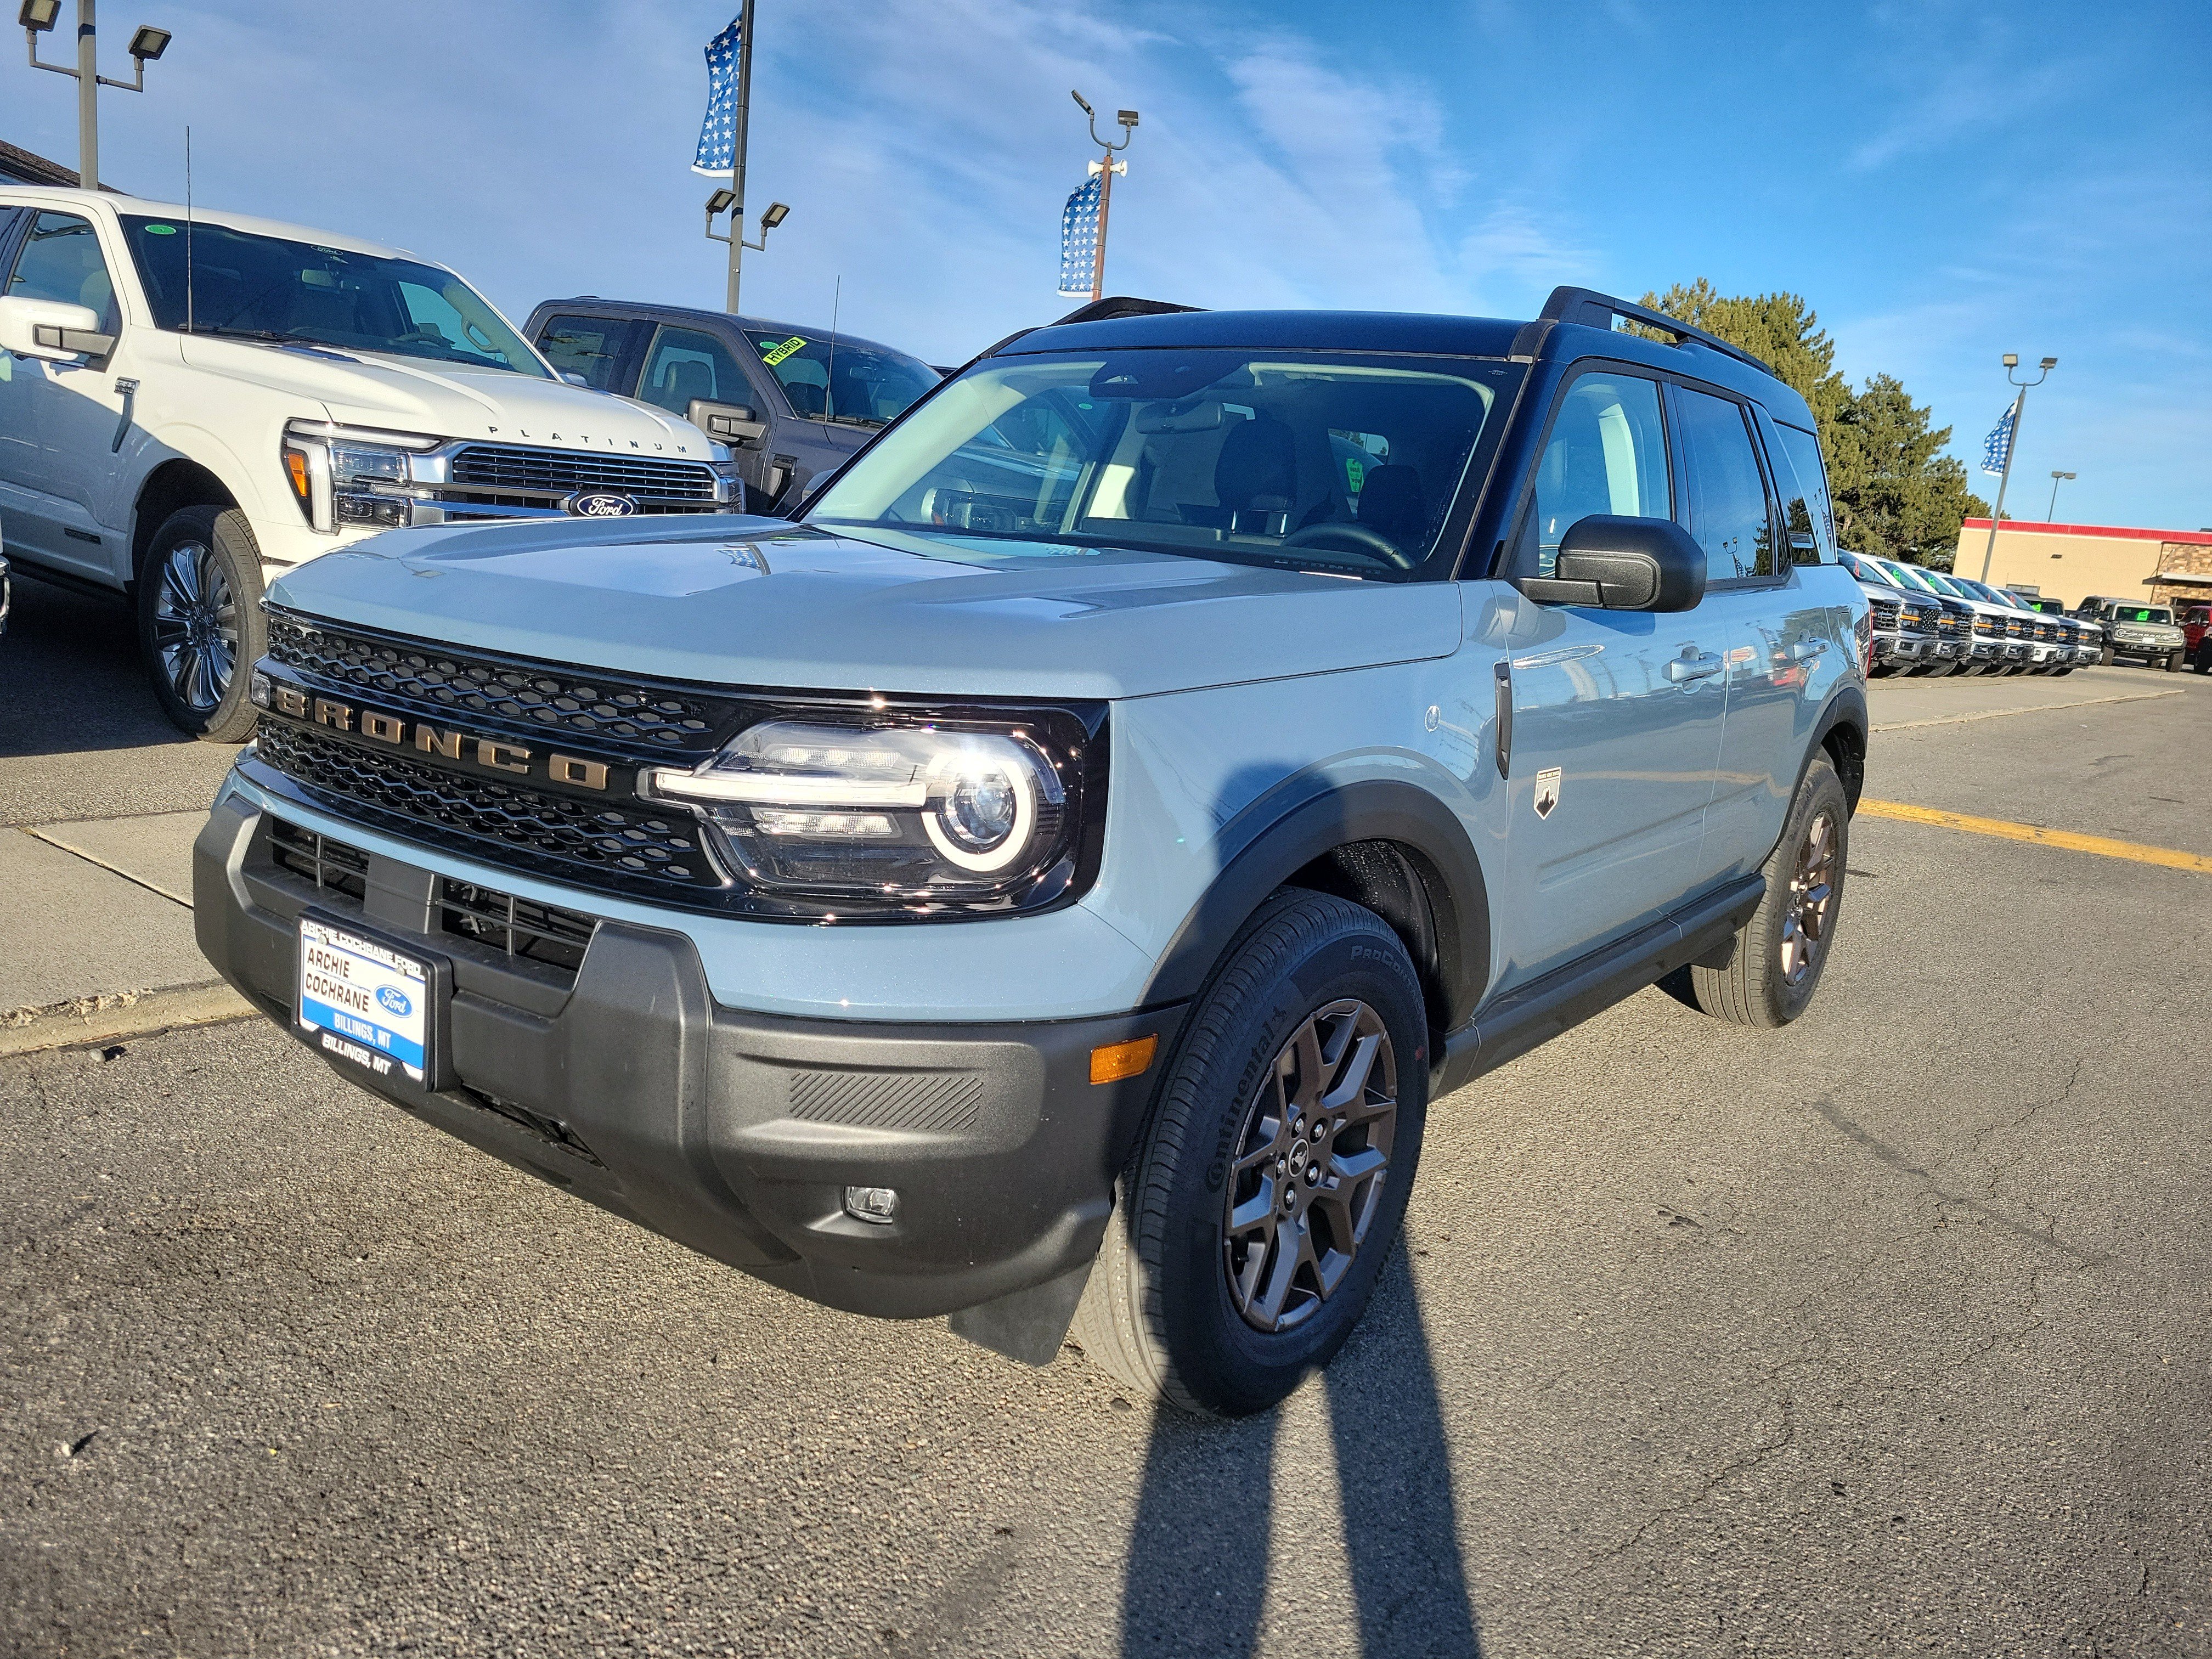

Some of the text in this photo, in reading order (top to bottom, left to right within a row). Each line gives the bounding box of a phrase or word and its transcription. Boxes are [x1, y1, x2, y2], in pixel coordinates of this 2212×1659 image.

[767, 339, 800, 363] HYBRID
[488, 426, 687, 453] PLATINUM
[588, 498, 623, 515] Ford
[276, 685, 608, 790] BRONCO
[302, 919, 422, 974] ARCHIE COCHRANE FORD
[307, 947, 350, 979] ARCHIE
[306, 973, 370, 1013] COCHRANE
[382, 988, 407, 1014] Ford
[334, 1012, 392, 1049] BILLINGS, MT
[322, 1032, 392, 1075] BILLINGS, MT
[1206, 1020, 1275, 1193] Continental
